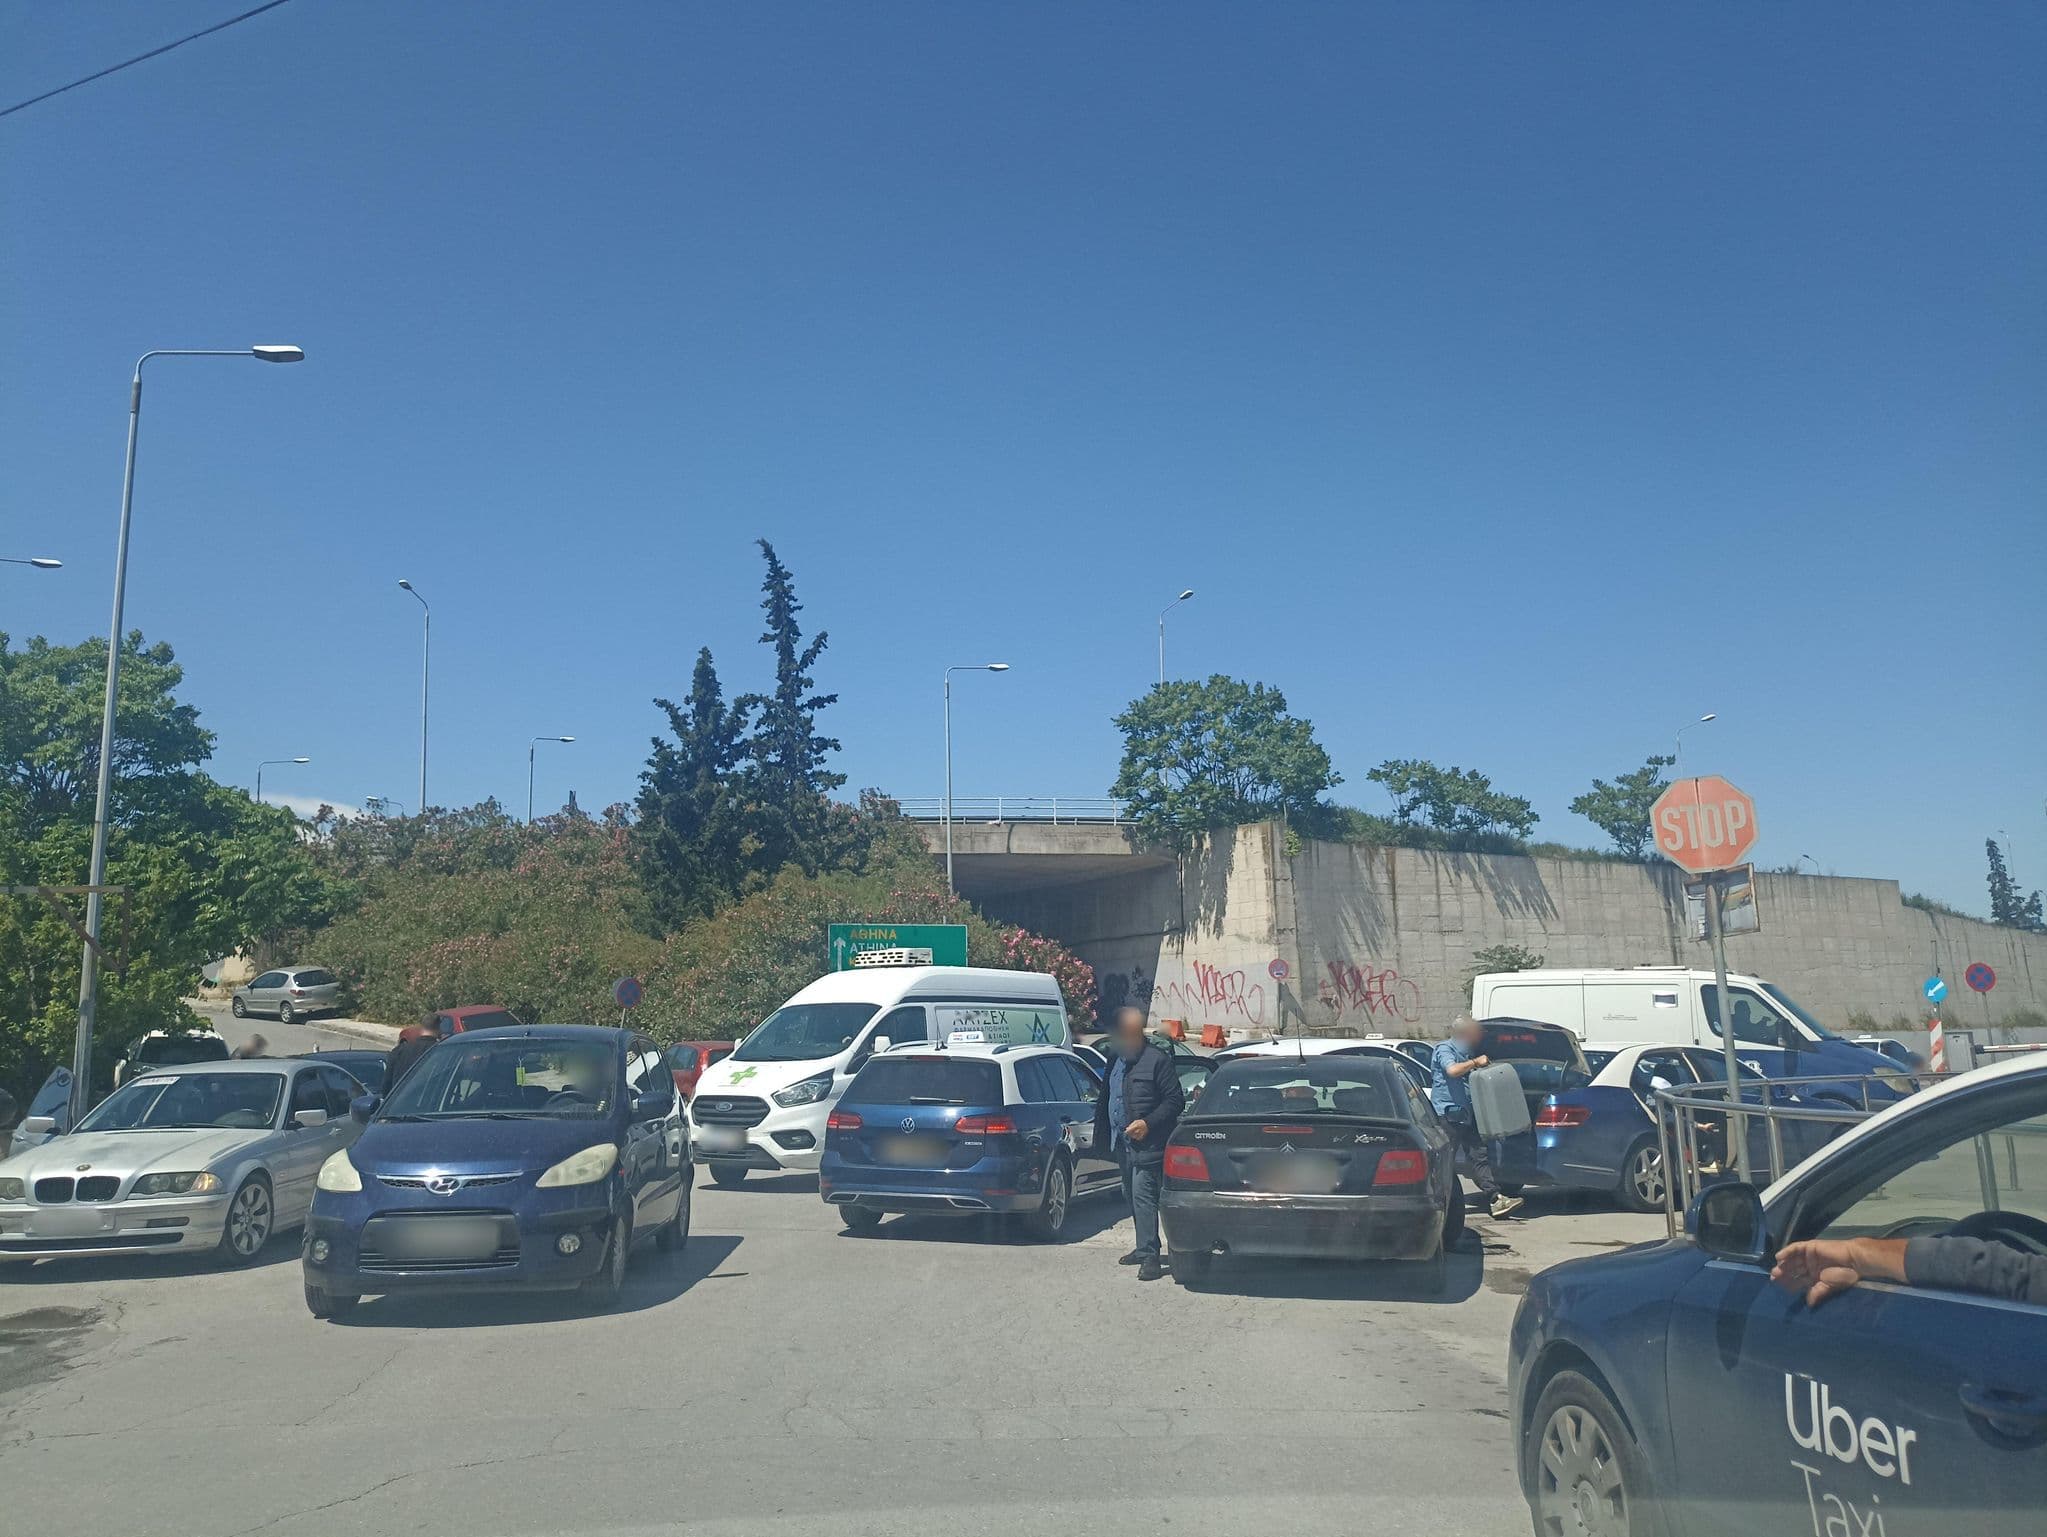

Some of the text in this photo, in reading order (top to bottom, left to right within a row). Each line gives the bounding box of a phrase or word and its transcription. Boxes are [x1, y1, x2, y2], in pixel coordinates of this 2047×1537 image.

[1661, 800, 1746, 851] STOP
[850, 928, 897, 940] ΑΘΗΝΑ
[1785, 1373, 1916, 1485] Uber
[1791, 1460, 1886, 1537] Taxi
